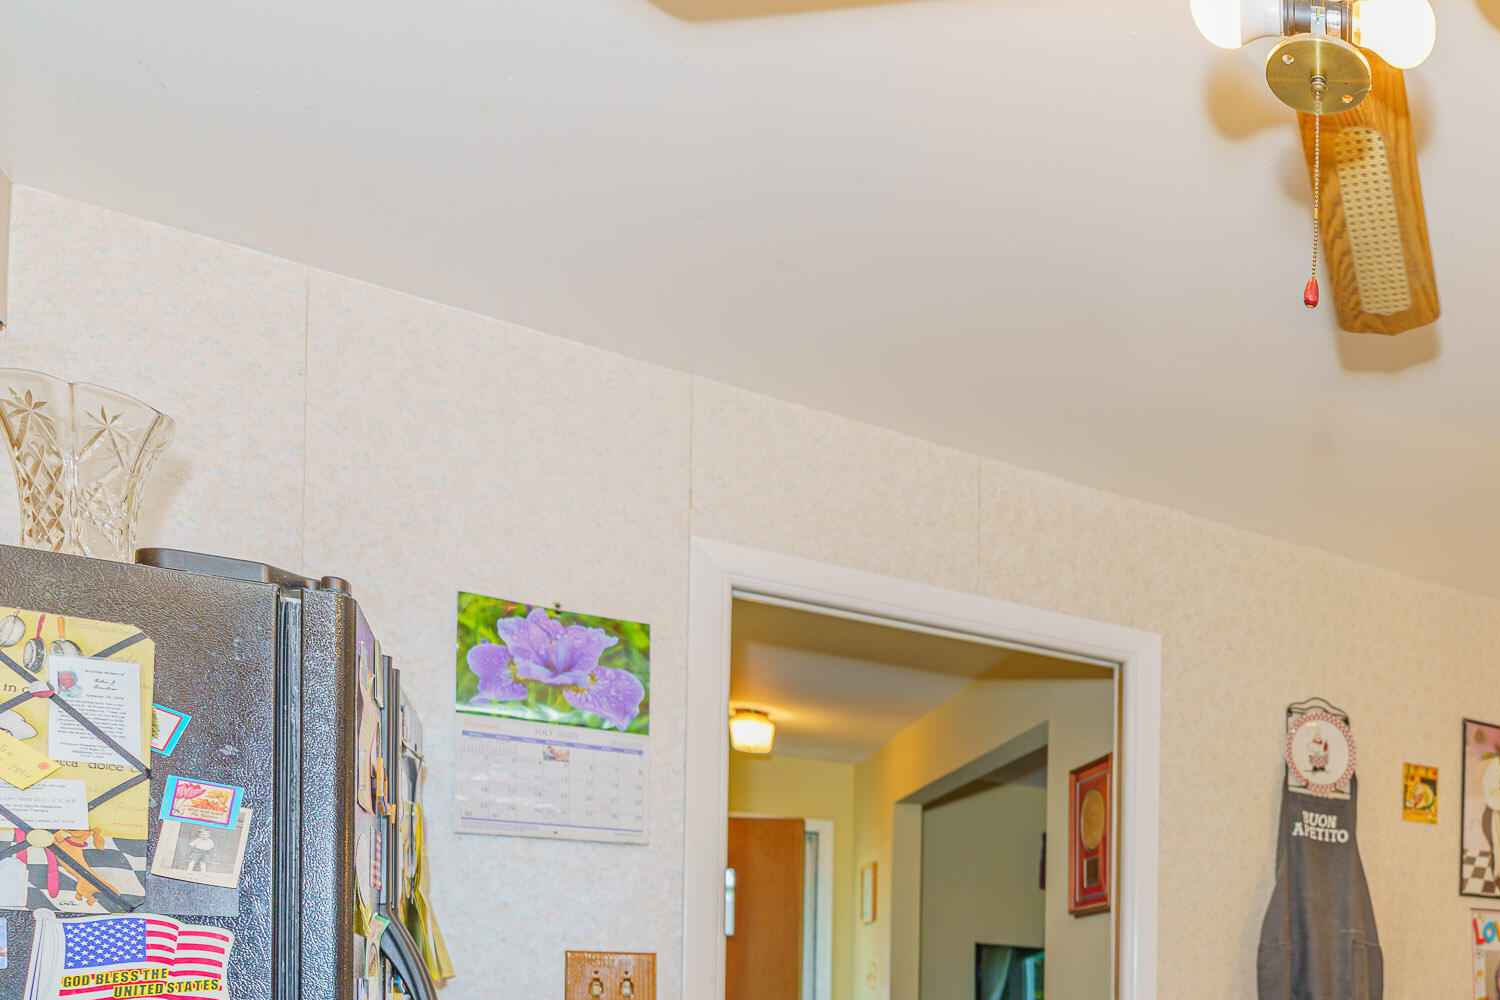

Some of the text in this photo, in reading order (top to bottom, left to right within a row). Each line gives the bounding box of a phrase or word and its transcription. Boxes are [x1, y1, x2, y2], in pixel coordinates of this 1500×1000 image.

[1302, 810, 1337, 828] BUON
[1292, 822, 1349, 843] APETITO
[63, 967, 168, 988] GOD BLESS THE
[113, 978, 219, 998] UNITED STATES
